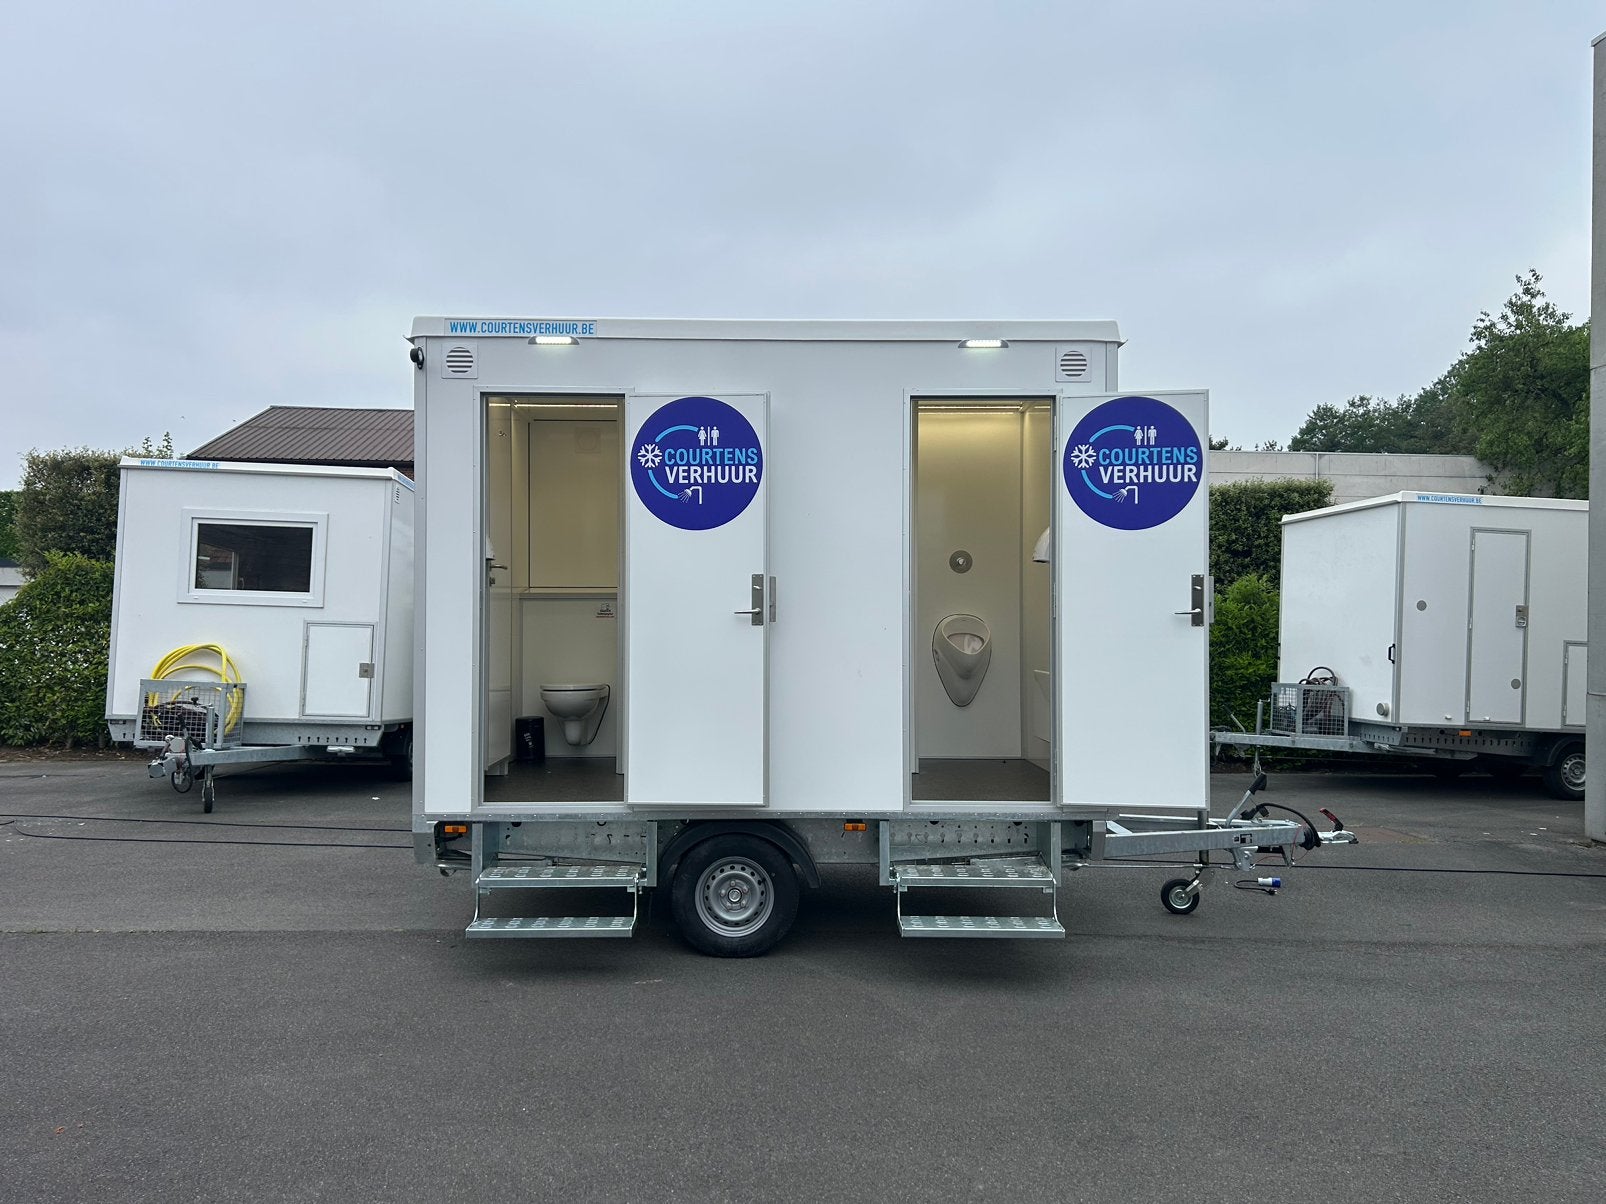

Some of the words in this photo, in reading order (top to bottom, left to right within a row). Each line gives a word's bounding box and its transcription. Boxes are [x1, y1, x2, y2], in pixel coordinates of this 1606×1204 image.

[450, 321, 594, 335] WWW.COURTENSVERHUUR.BE
[664, 448, 759, 465] COURTENS
[1099, 446, 1198, 465] COURTENS
[664, 465, 758, 484] VERHUUR
[1099, 464, 1198, 484] VERHUUR
